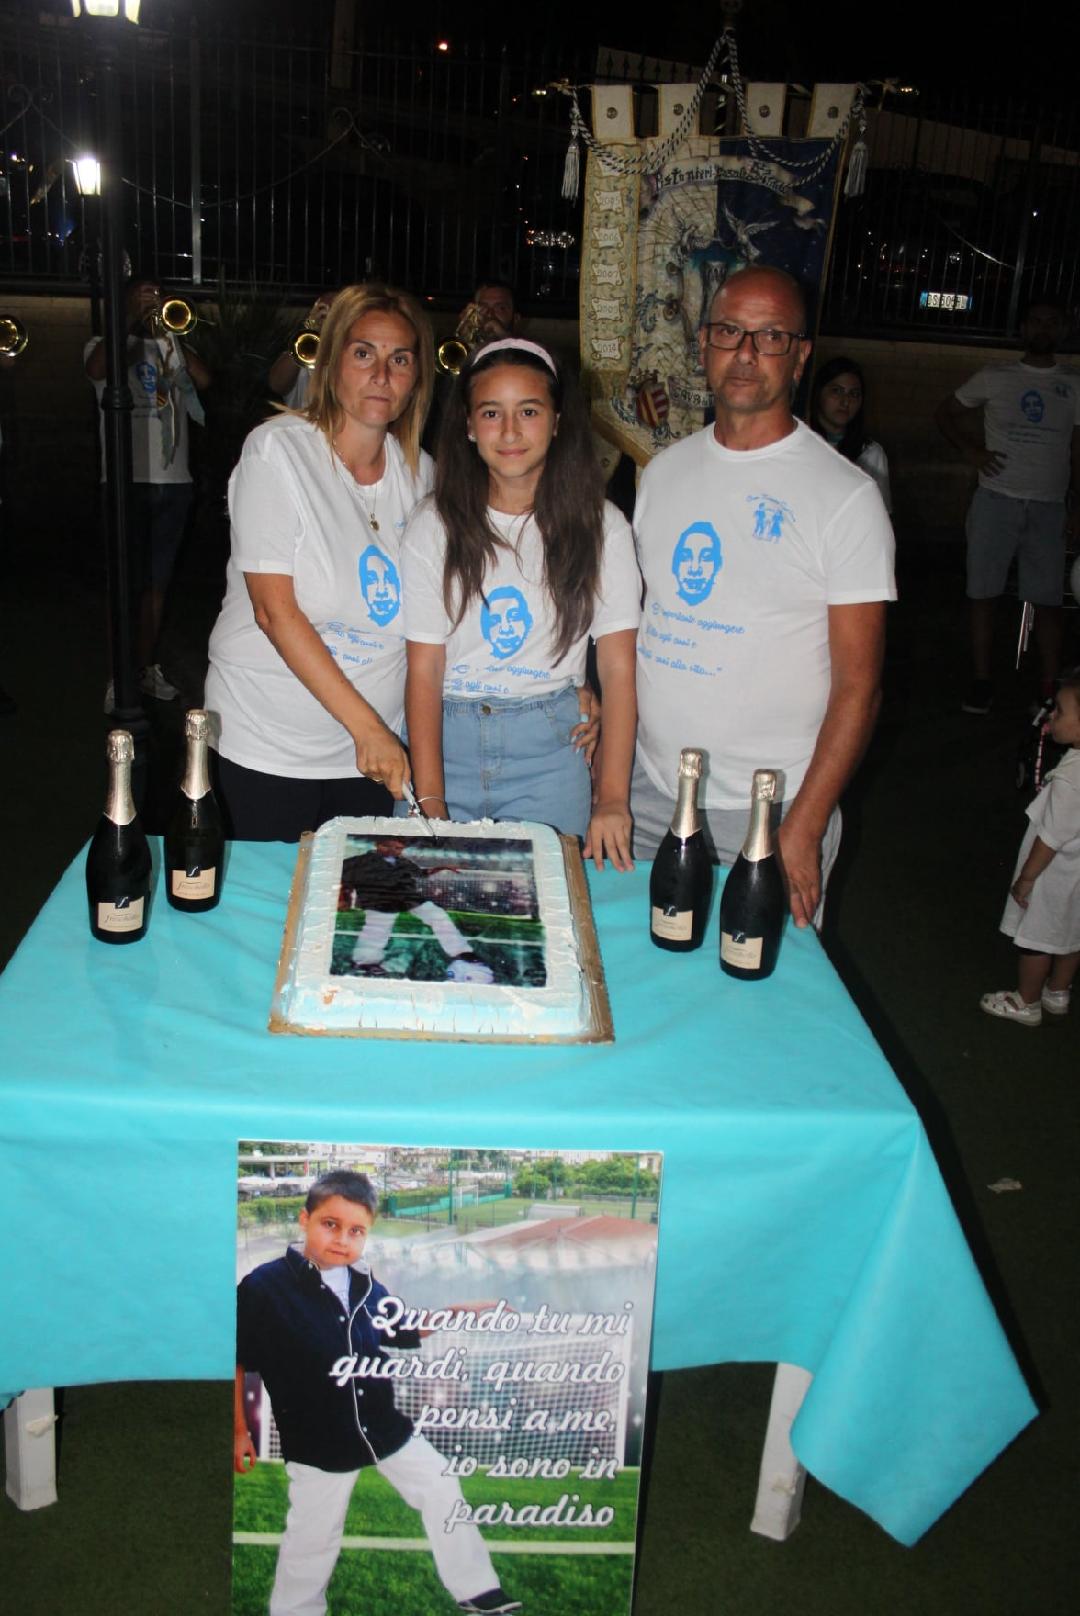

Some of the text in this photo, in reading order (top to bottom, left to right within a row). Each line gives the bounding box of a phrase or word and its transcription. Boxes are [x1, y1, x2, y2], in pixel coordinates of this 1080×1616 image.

[371, 1296, 634, 1337] Quando tu mi
[329, 1347, 626, 1391] guardi, quando
[414, 1397, 517, 1438] pensi
[522, 1407, 549, 1431] a
[442, 1444, 620, 1479] io sono in
[444, 1494, 615, 1533] paradiso
